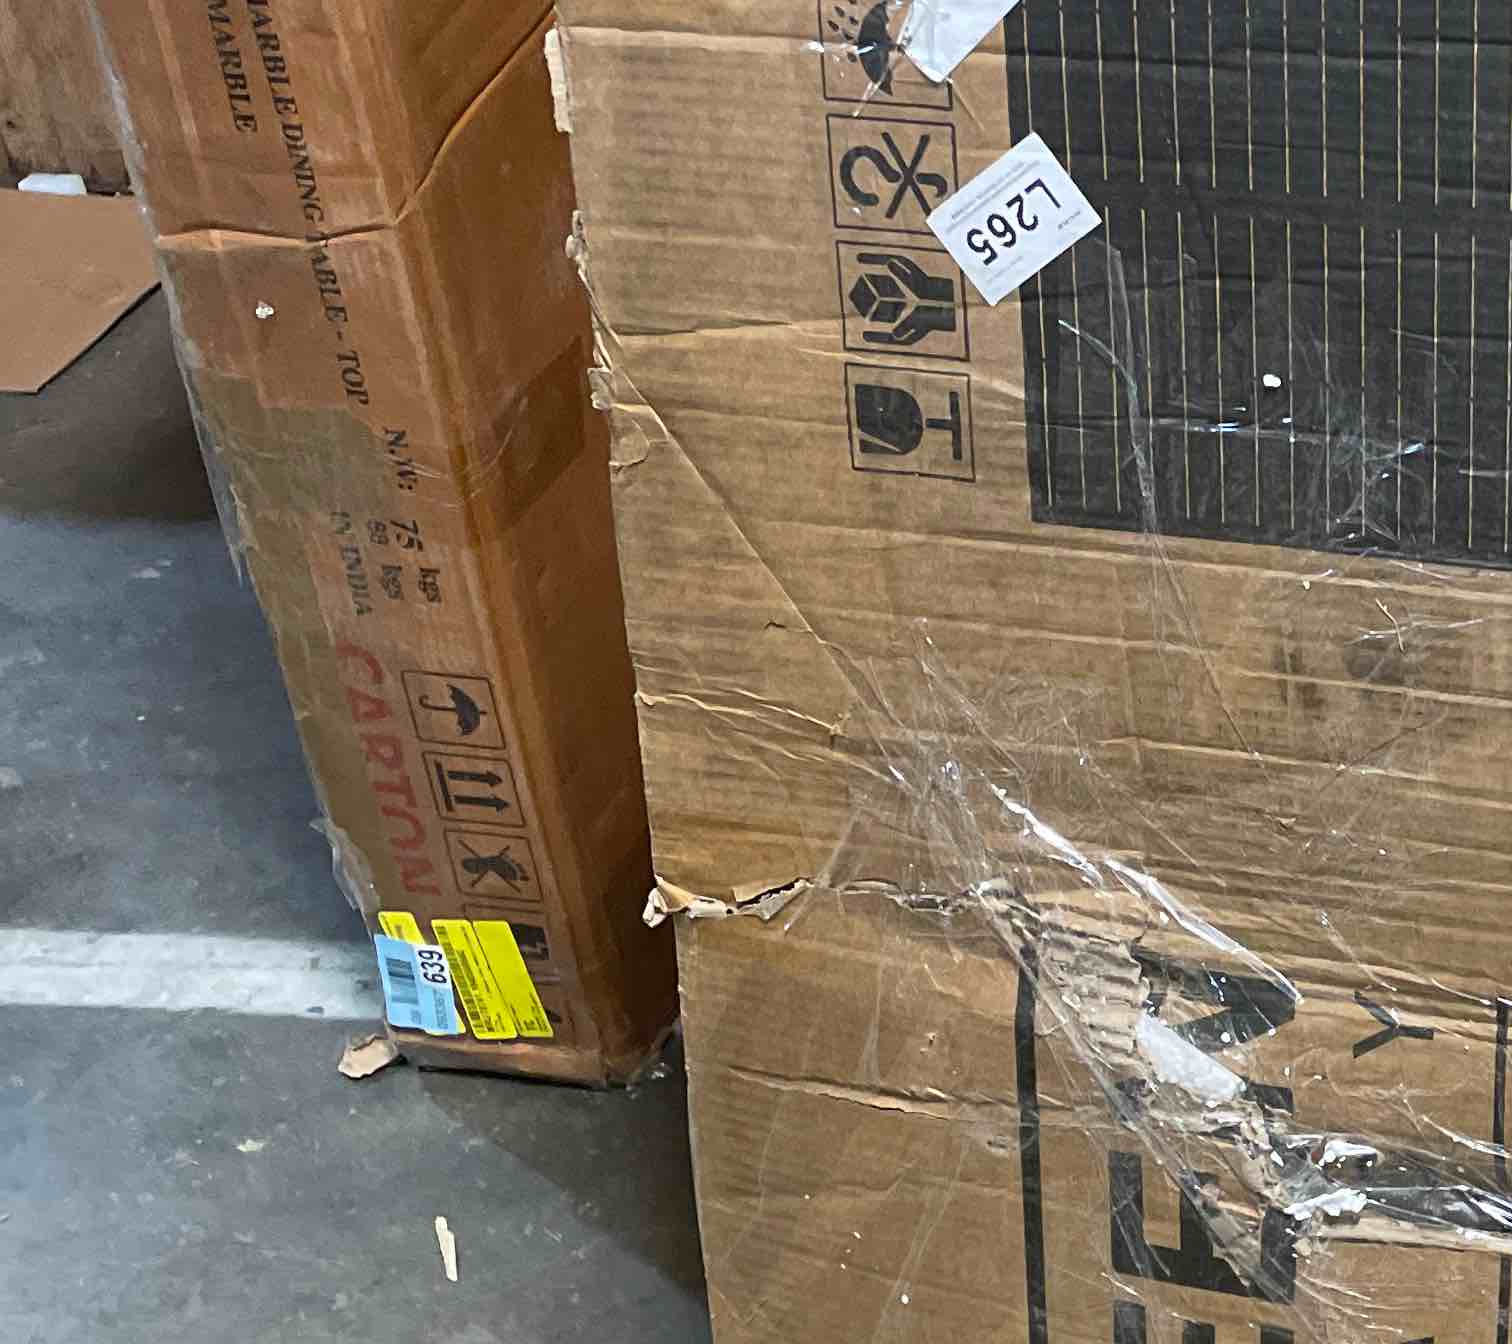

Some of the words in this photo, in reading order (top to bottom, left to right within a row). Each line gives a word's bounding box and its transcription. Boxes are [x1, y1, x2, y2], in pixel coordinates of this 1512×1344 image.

[967, 178, 1061, 266] L265
[281, 123, 324, 225] DINING
[336, 349, 369, 406] TOP
[417, 567, 442, 604] kgs
[418, 950, 447, 985] 639
